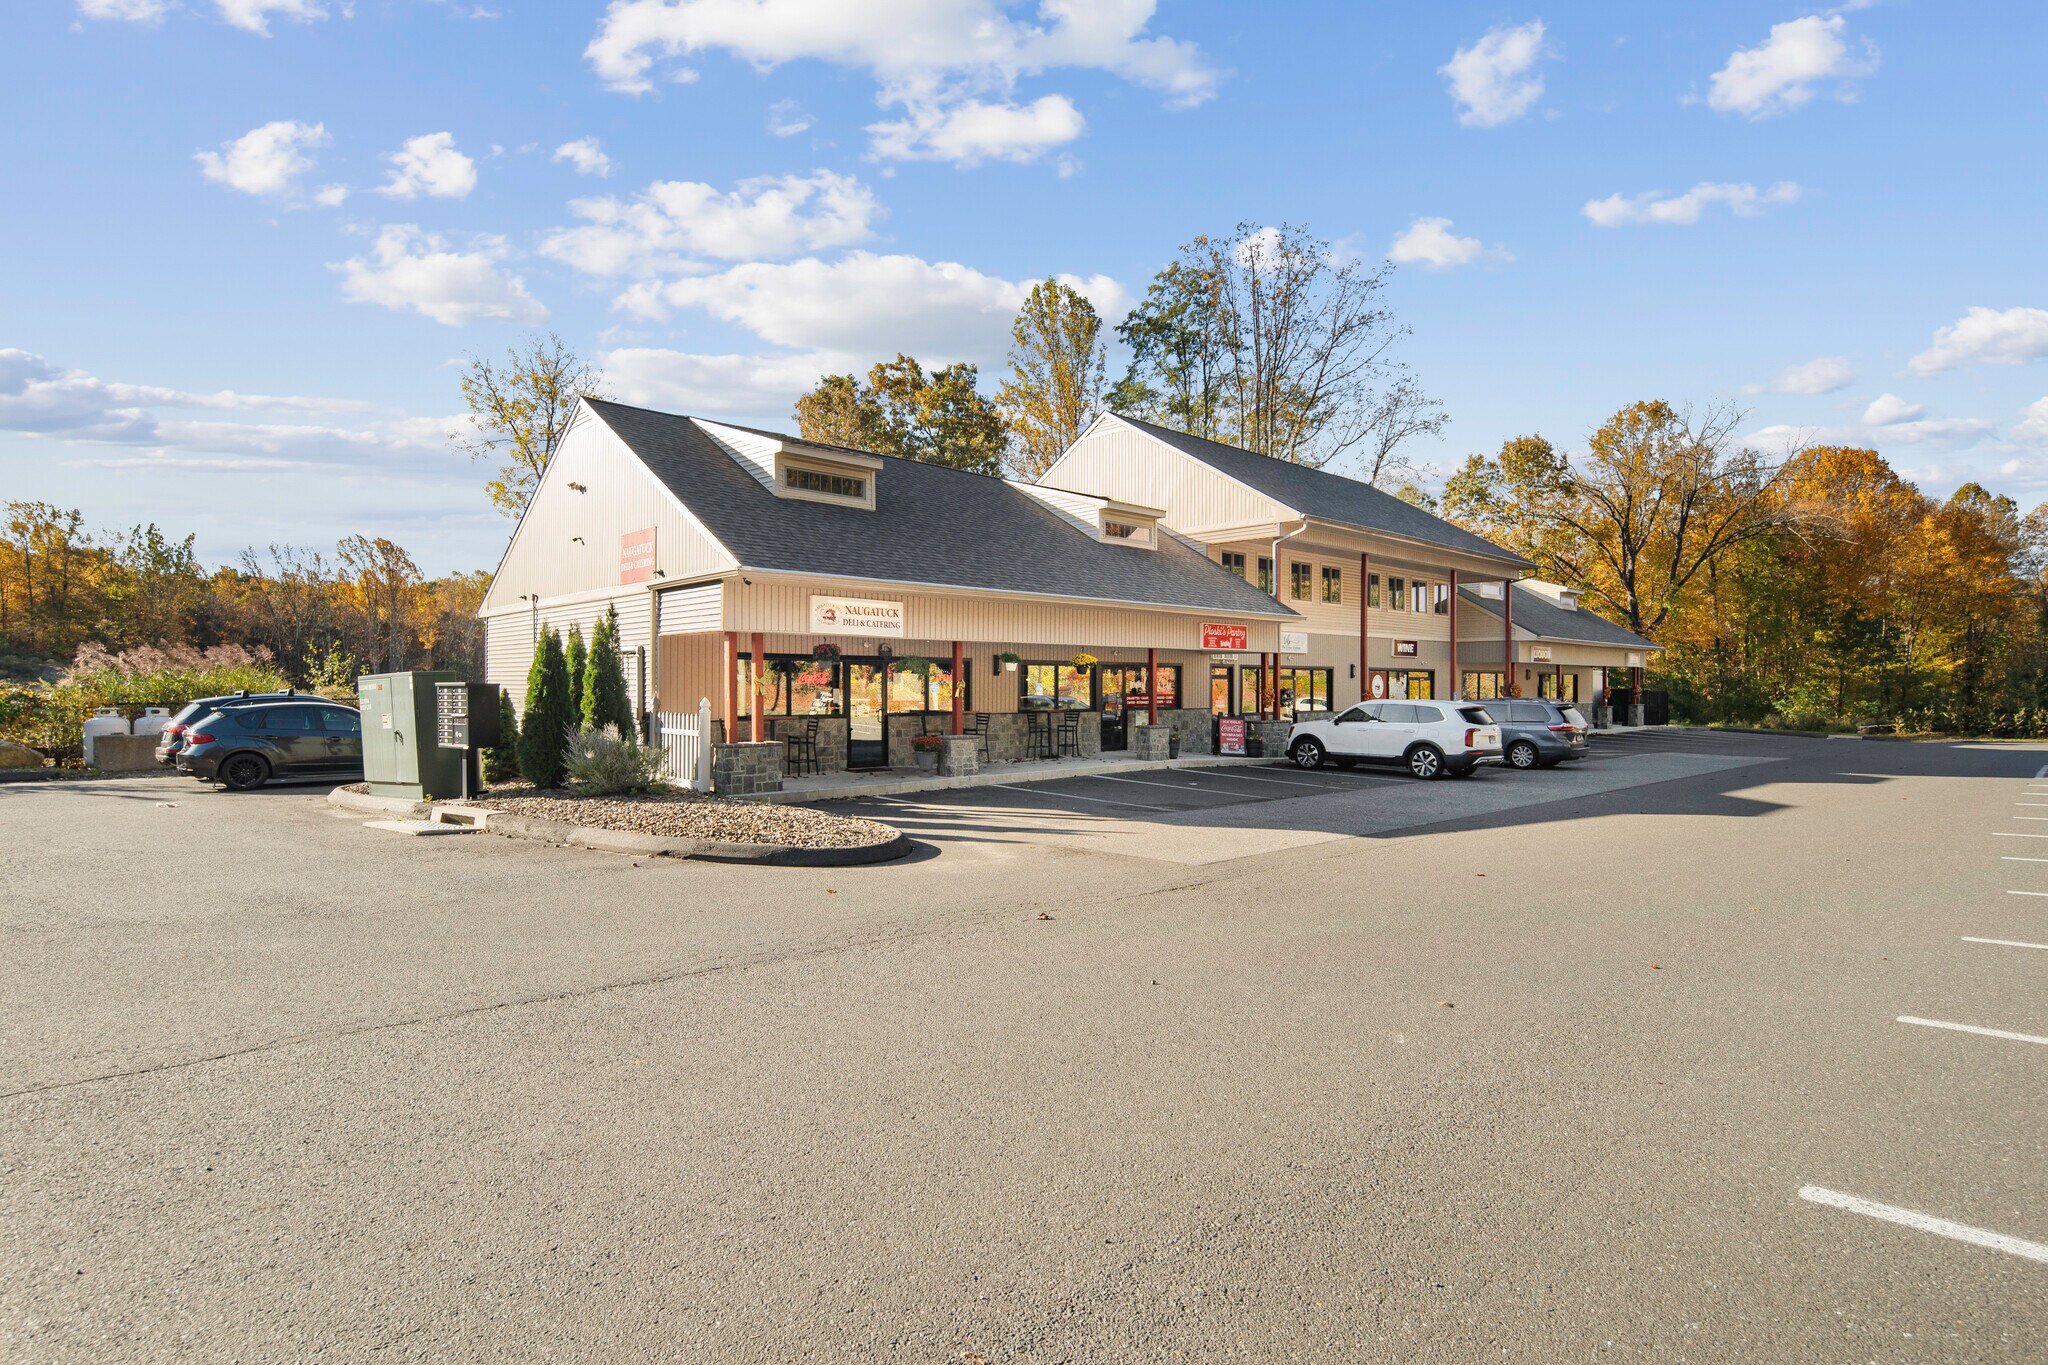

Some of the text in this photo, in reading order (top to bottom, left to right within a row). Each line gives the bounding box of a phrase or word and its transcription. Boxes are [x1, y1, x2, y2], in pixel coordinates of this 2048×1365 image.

[622, 541, 654, 558] NAUGATUCK
[845, 605, 899, 618] NAUGATUCK
[843, 618, 901, 630] DELI & CATERING
[1226, 625, 1246, 640] Pantry
[1397, 643, 1415, 653] WINE
